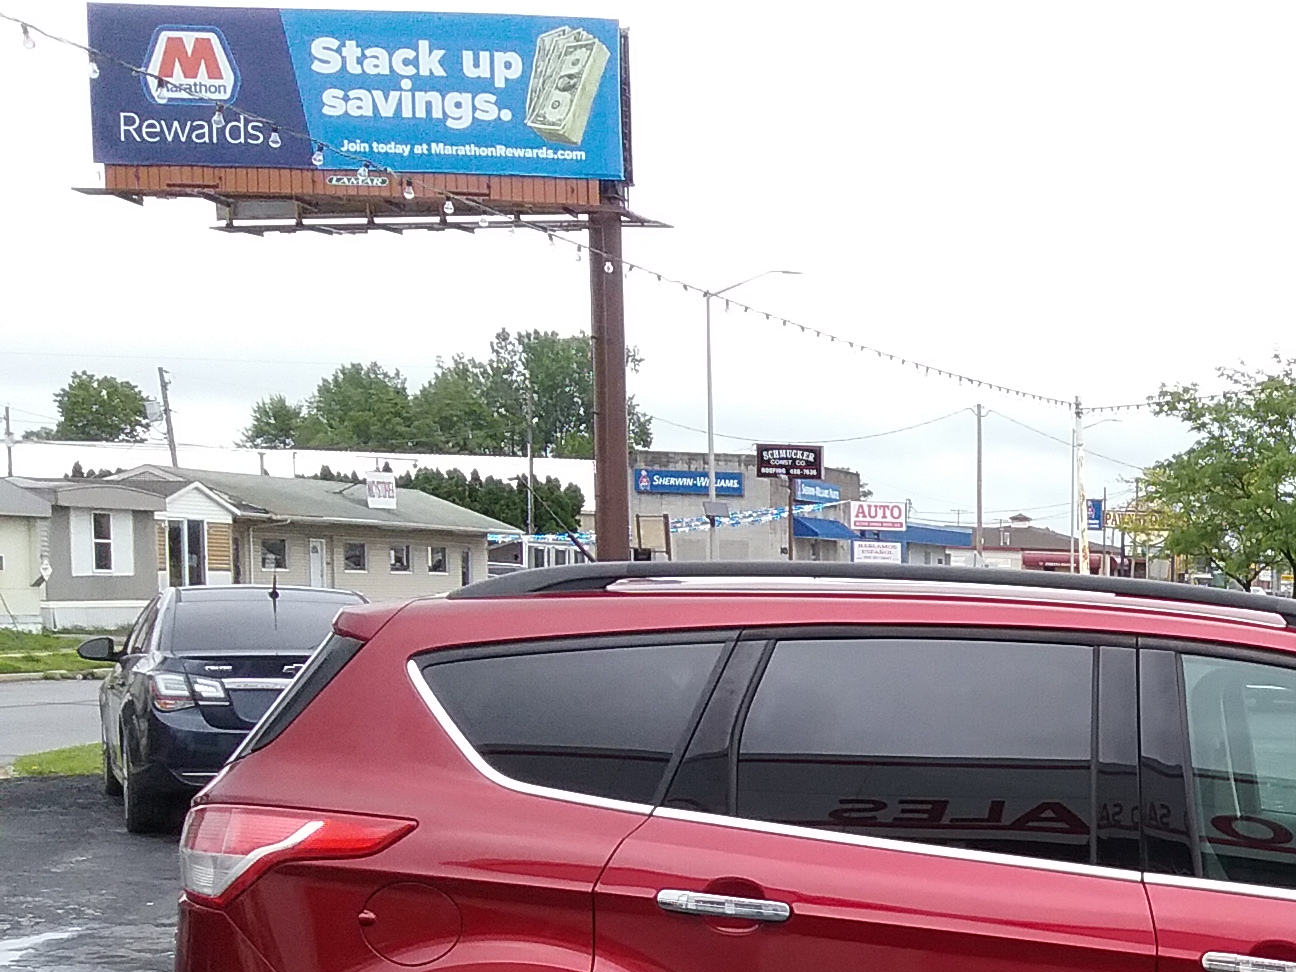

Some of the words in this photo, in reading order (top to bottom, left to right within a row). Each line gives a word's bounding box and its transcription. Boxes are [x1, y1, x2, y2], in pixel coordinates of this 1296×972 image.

[157, 36, 225, 81] M
[310, 37, 447, 77] Stack
[462, 50, 523, 88] up
[321, 79, 513, 129] savings.
[119, 112, 264, 144] Rewards
[340, 140, 368, 153] Join
[372, 141, 411, 155] today
[413, 143, 428, 154] at
[431, 142, 586, 160] MarathonRewards.com
[332, 176, 383, 186] LAMAR
[762, 449, 815, 462] SCHMUCKER
[854, 503, 902, 520] AUTO
